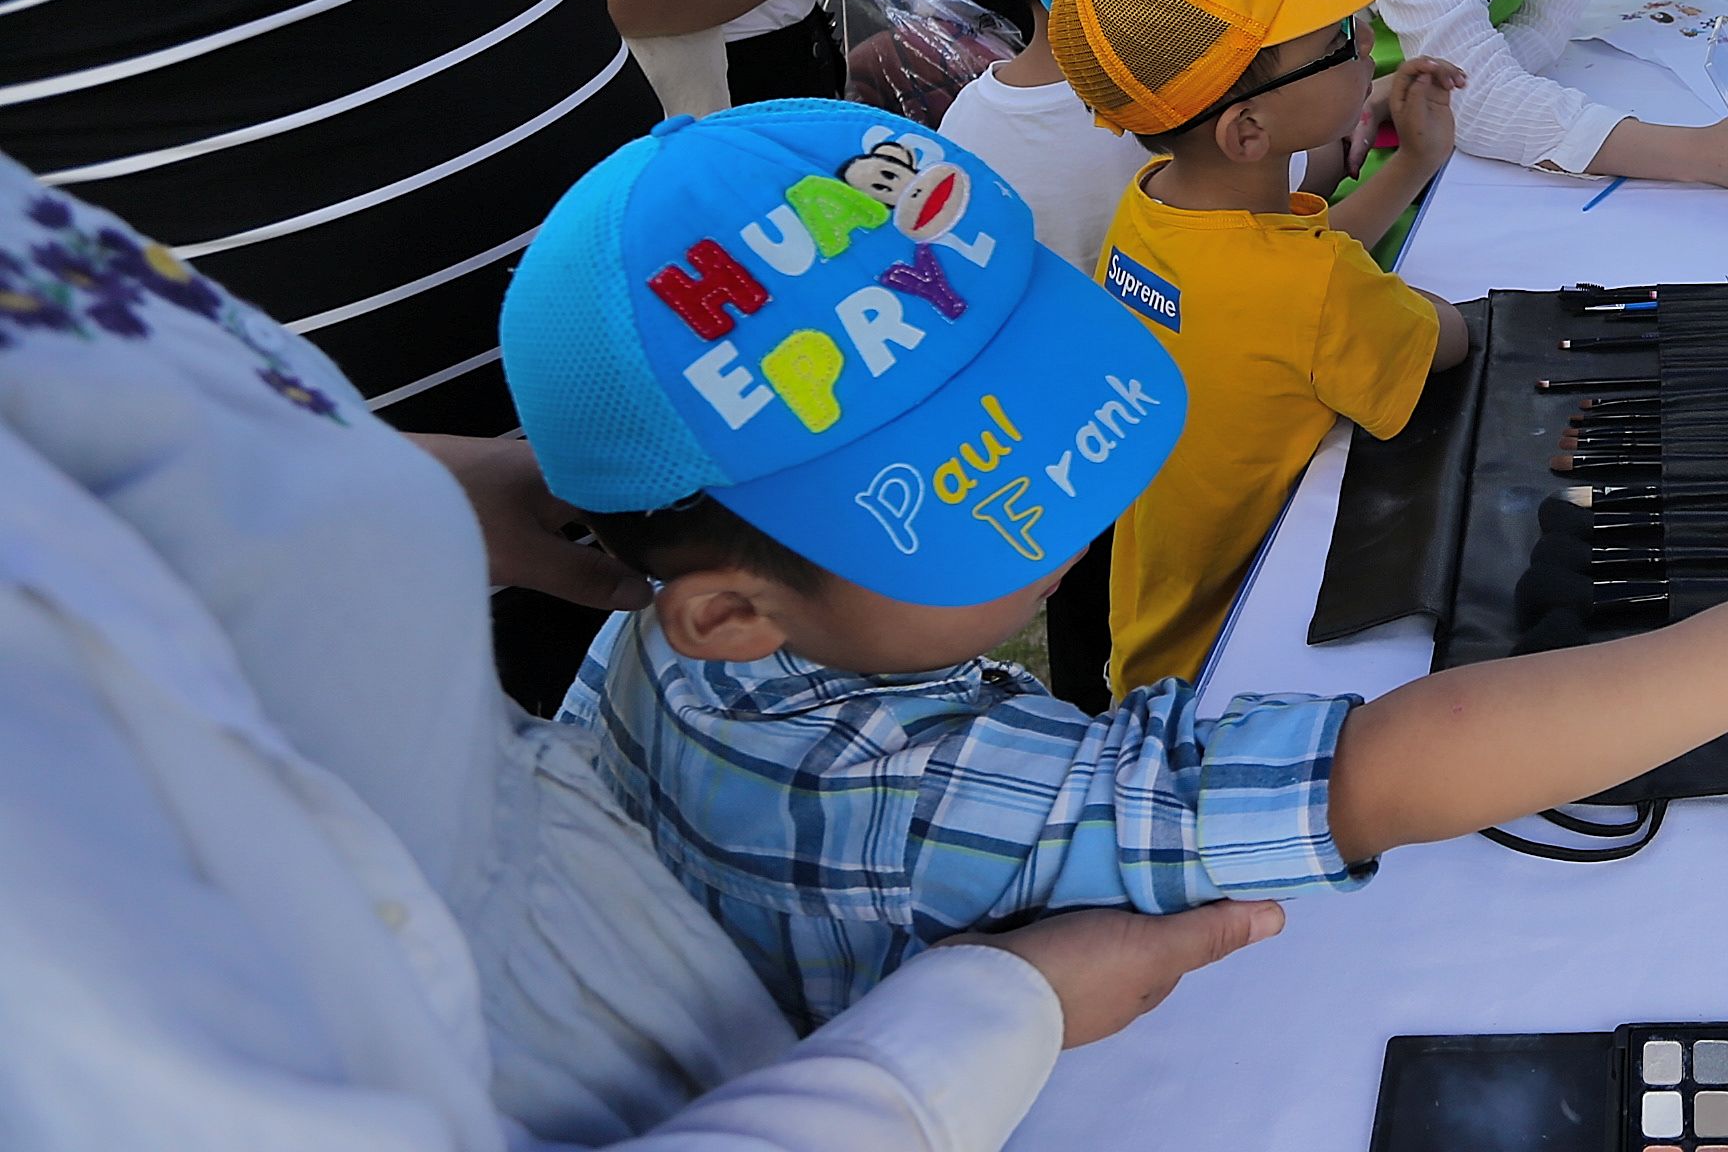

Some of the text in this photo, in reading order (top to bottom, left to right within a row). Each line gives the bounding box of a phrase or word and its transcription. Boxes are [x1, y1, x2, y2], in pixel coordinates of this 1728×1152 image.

[1108, 254, 1177, 317] Supreme
[855, 394, 1023, 555] Paul
[972, 375, 1161, 561] Frank
